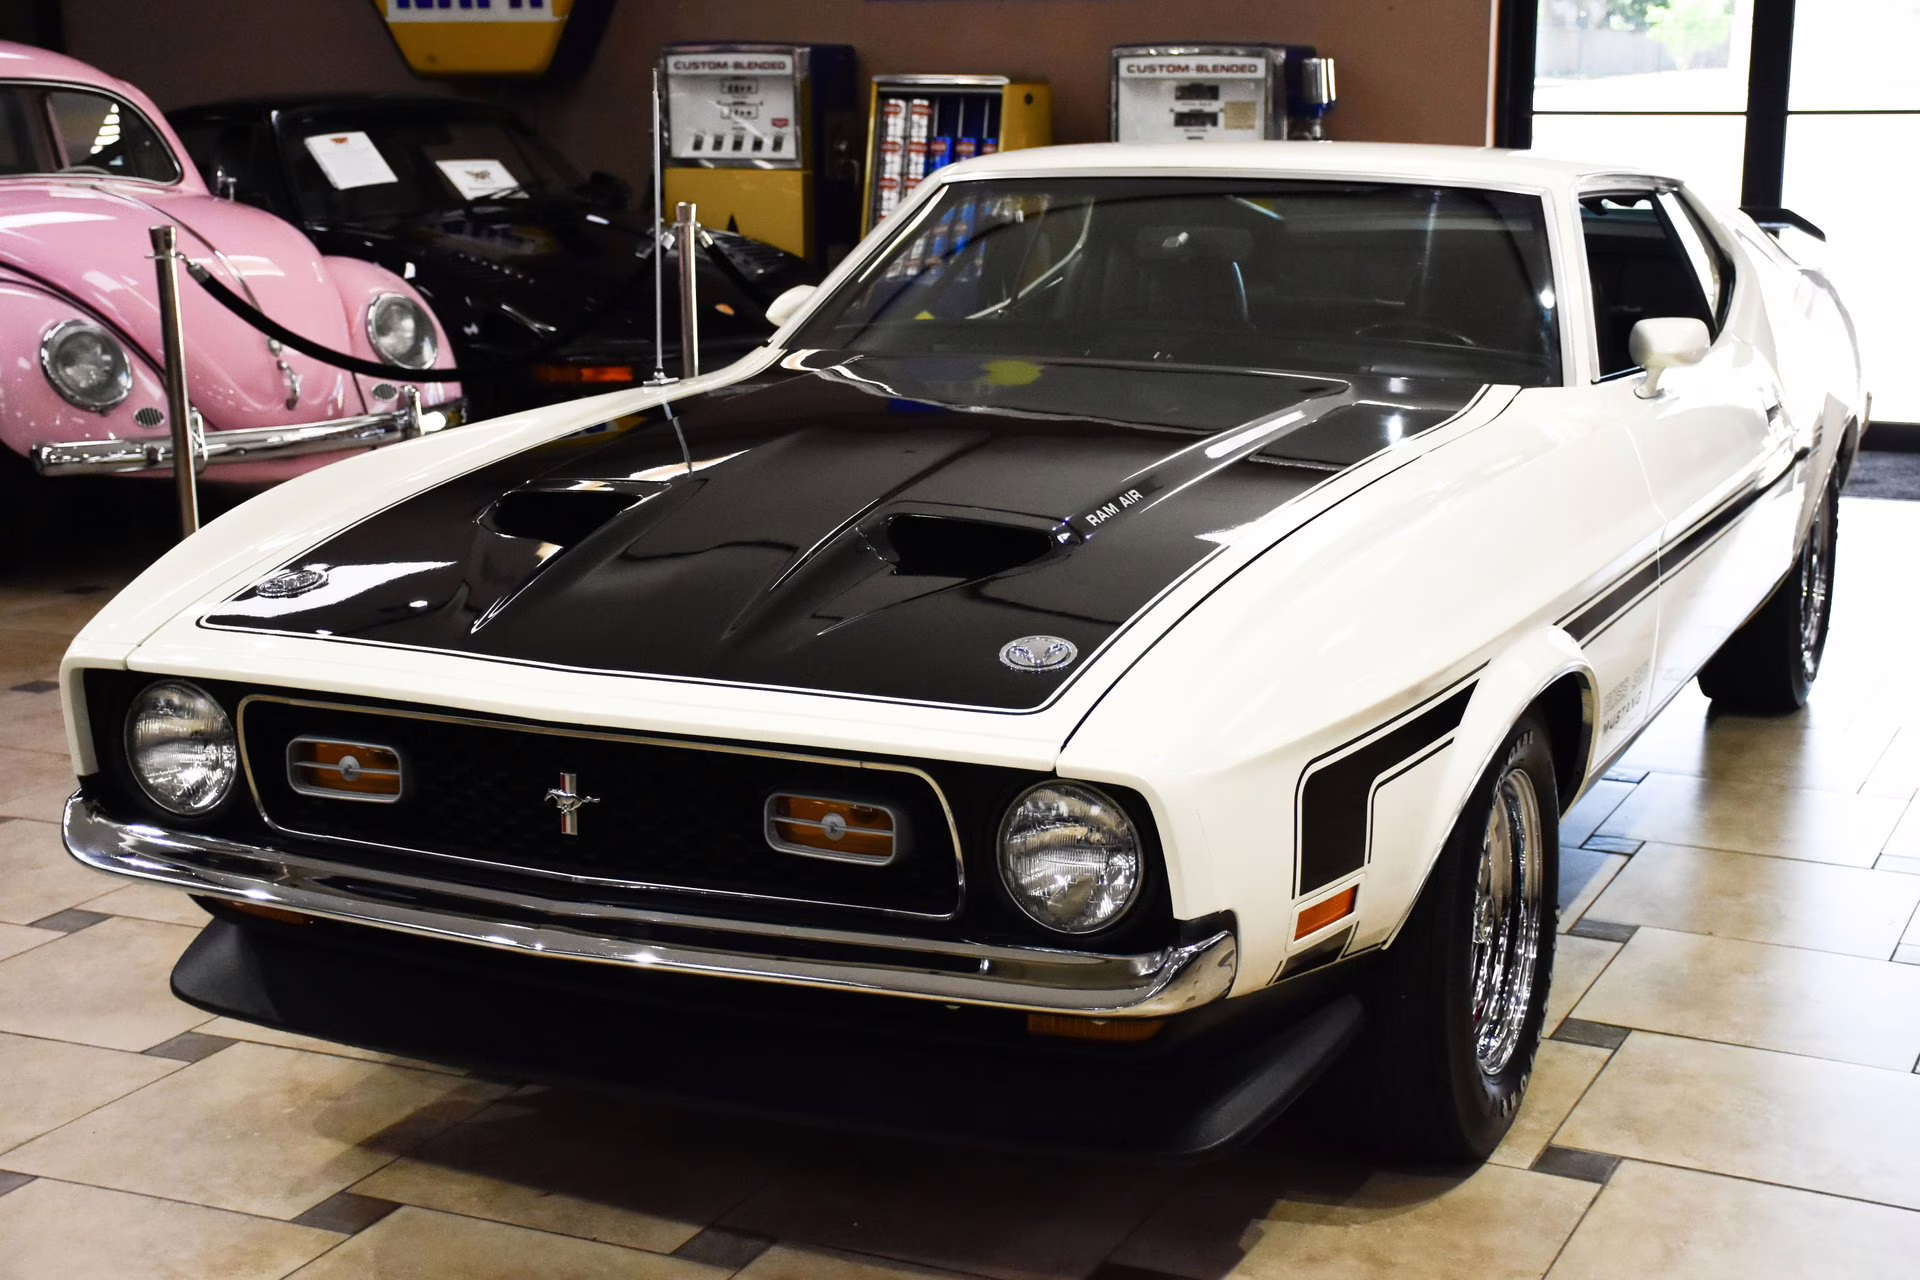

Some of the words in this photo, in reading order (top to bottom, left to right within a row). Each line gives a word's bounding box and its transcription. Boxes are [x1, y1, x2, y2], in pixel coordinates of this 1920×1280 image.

[673, 60, 786, 71] CUSTOM-BLENDED
[1126, 63, 1258, 74] CUSTOM-BLENDED
[1085, 502, 1120, 527] RAM
[1118, 489, 1143, 508] AIR
